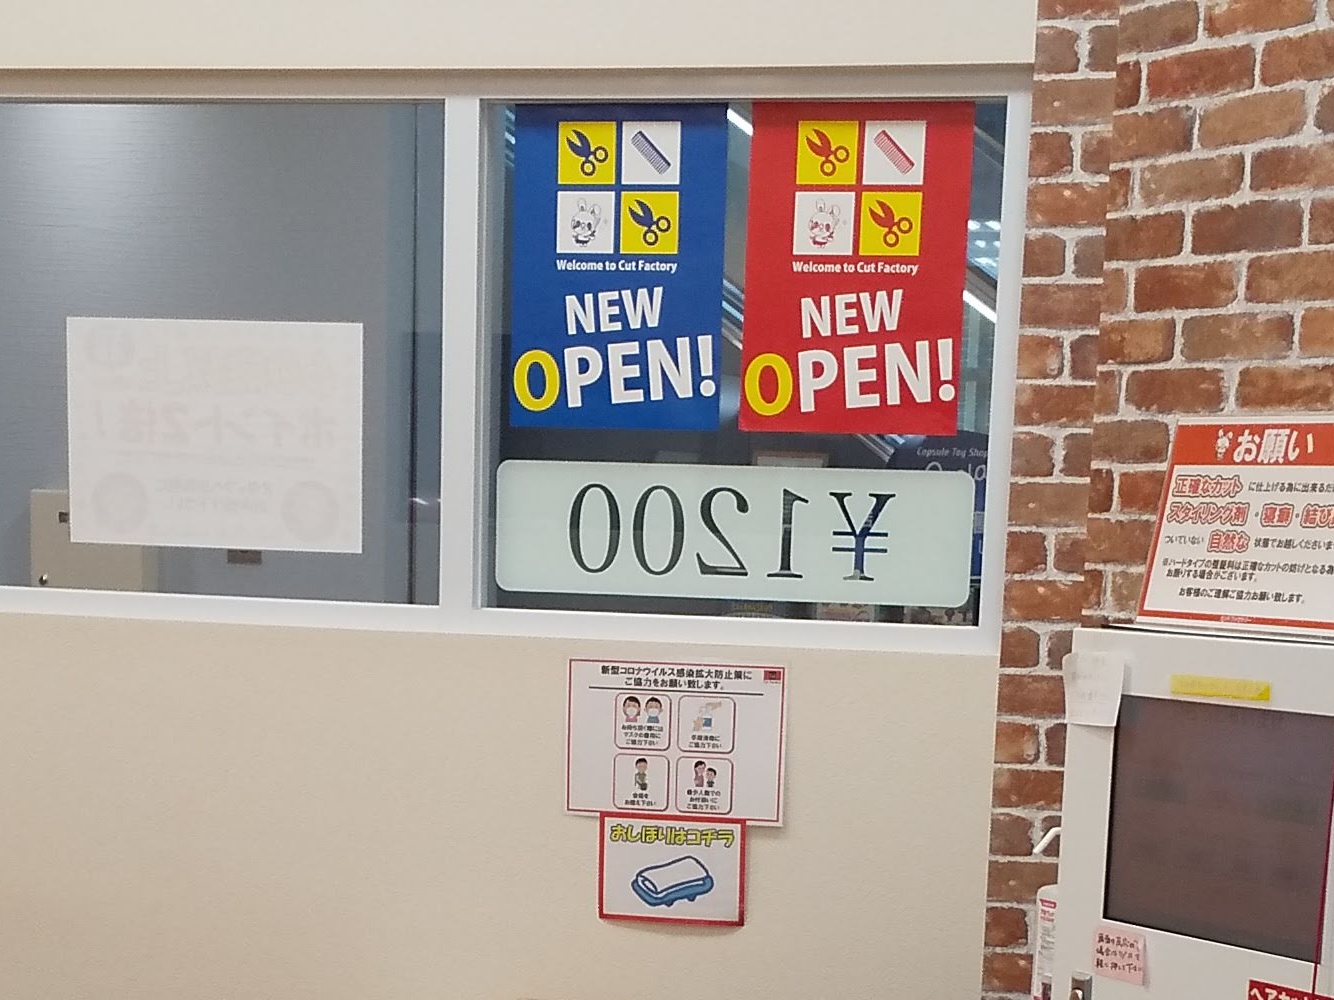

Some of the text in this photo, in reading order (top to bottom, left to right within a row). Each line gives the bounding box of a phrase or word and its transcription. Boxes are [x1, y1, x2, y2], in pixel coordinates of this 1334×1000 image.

[556, 259, 678, 274] Welcome to Cut Factory
[792, 261, 919, 276] Welcome to Cut Factory
[564, 286, 664, 335] NEW
[800, 288, 903, 338] NEW
[513, 334, 716, 412] OPEN!
[745, 338, 956, 416] OPEN!
[952, 447, 966, 459] Toy
[1233, 428, 1314, 464] お願い
[610, 823, 735, 848] おしぼりはコチラ
